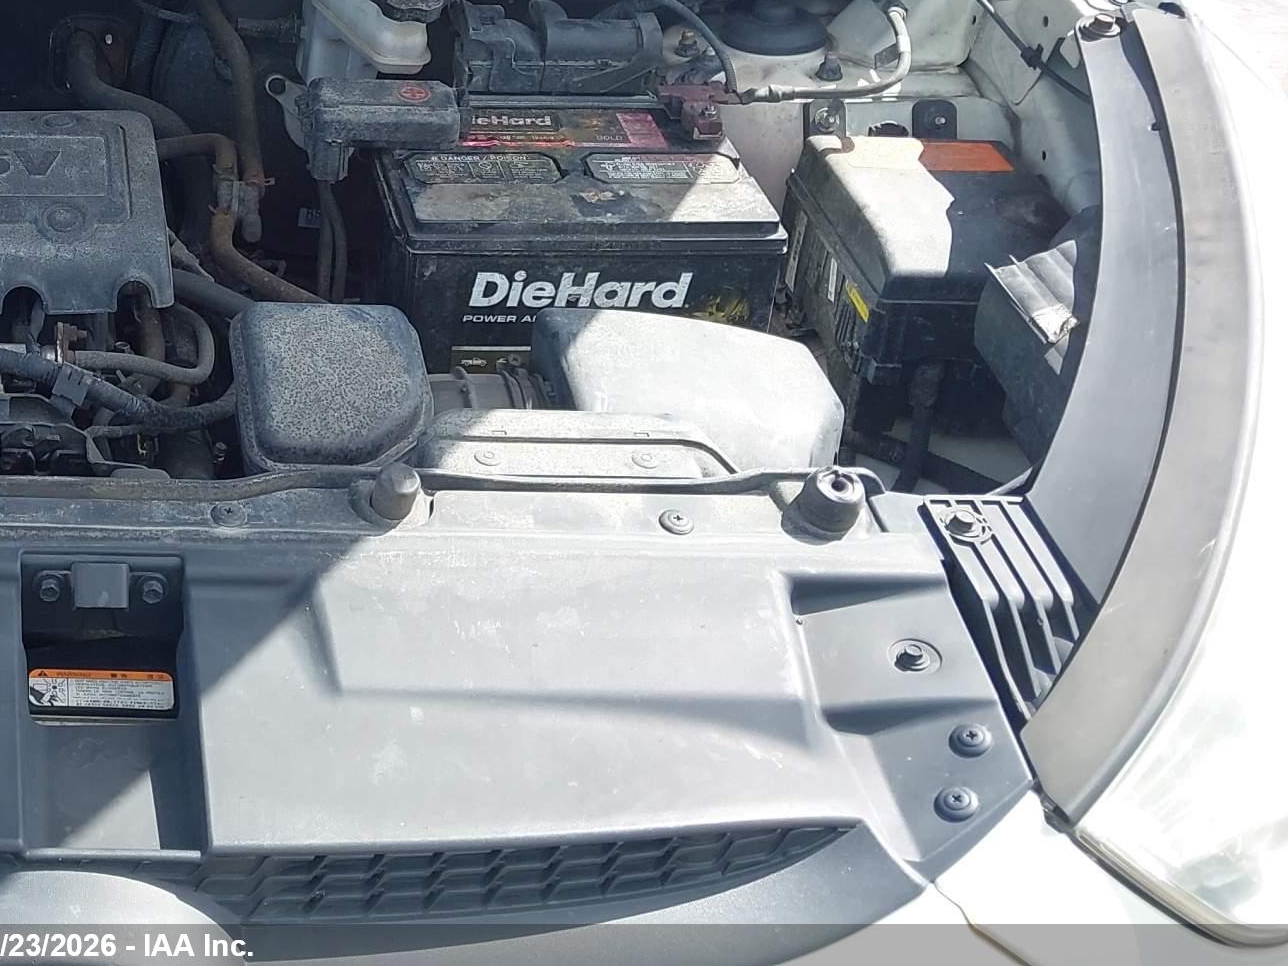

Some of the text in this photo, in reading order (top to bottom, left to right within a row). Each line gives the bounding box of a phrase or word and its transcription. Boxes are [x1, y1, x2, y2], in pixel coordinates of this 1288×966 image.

[471, 114, 552, 127] ieHard
[489, 154, 527, 162] POISON
[468, 269, 694, 309] DieHard
[462, 314, 518, 323] POWER
